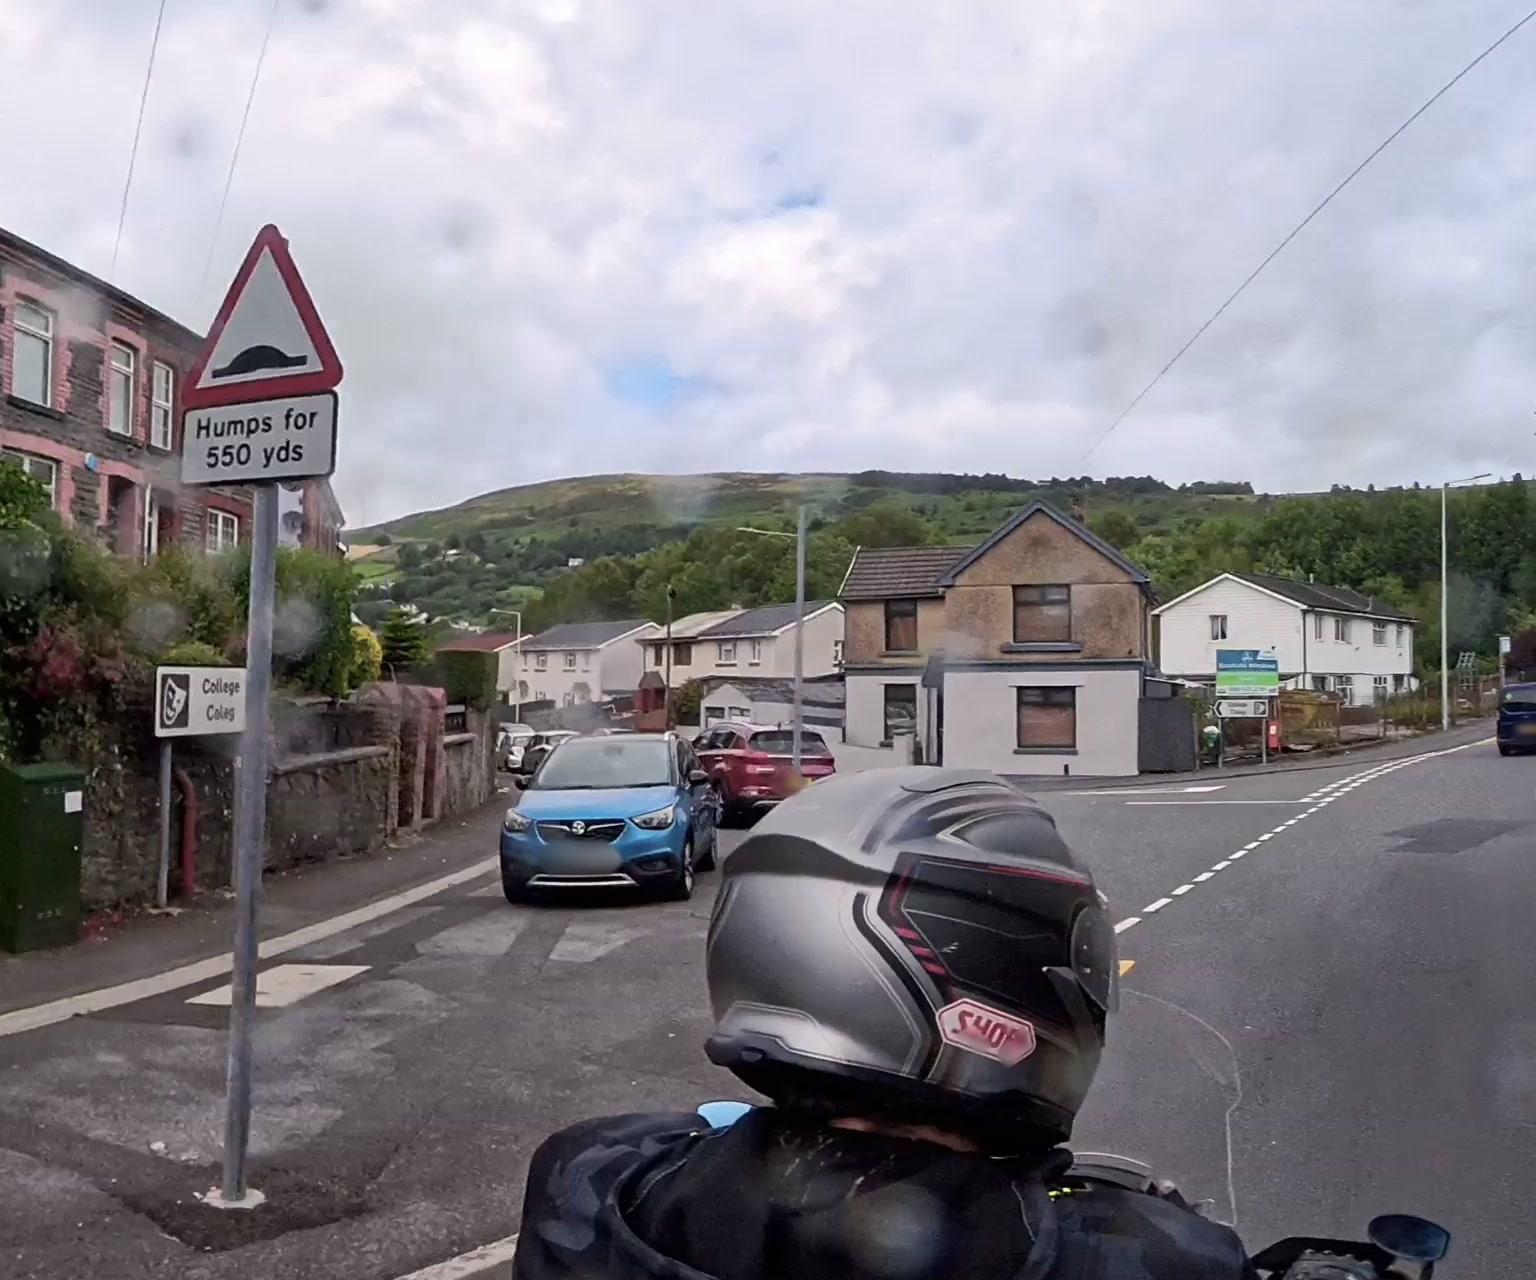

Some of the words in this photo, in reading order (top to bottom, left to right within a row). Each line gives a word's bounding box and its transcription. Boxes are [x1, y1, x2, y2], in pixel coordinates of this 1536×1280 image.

[196, 415, 272, 439] Humps
[284, 407, 318, 431] for
[206, 443, 251, 468] 550
[262, 439, 304, 468] yds
[202, 678, 240, 696] College
[206, 704, 235, 722] Coleg
